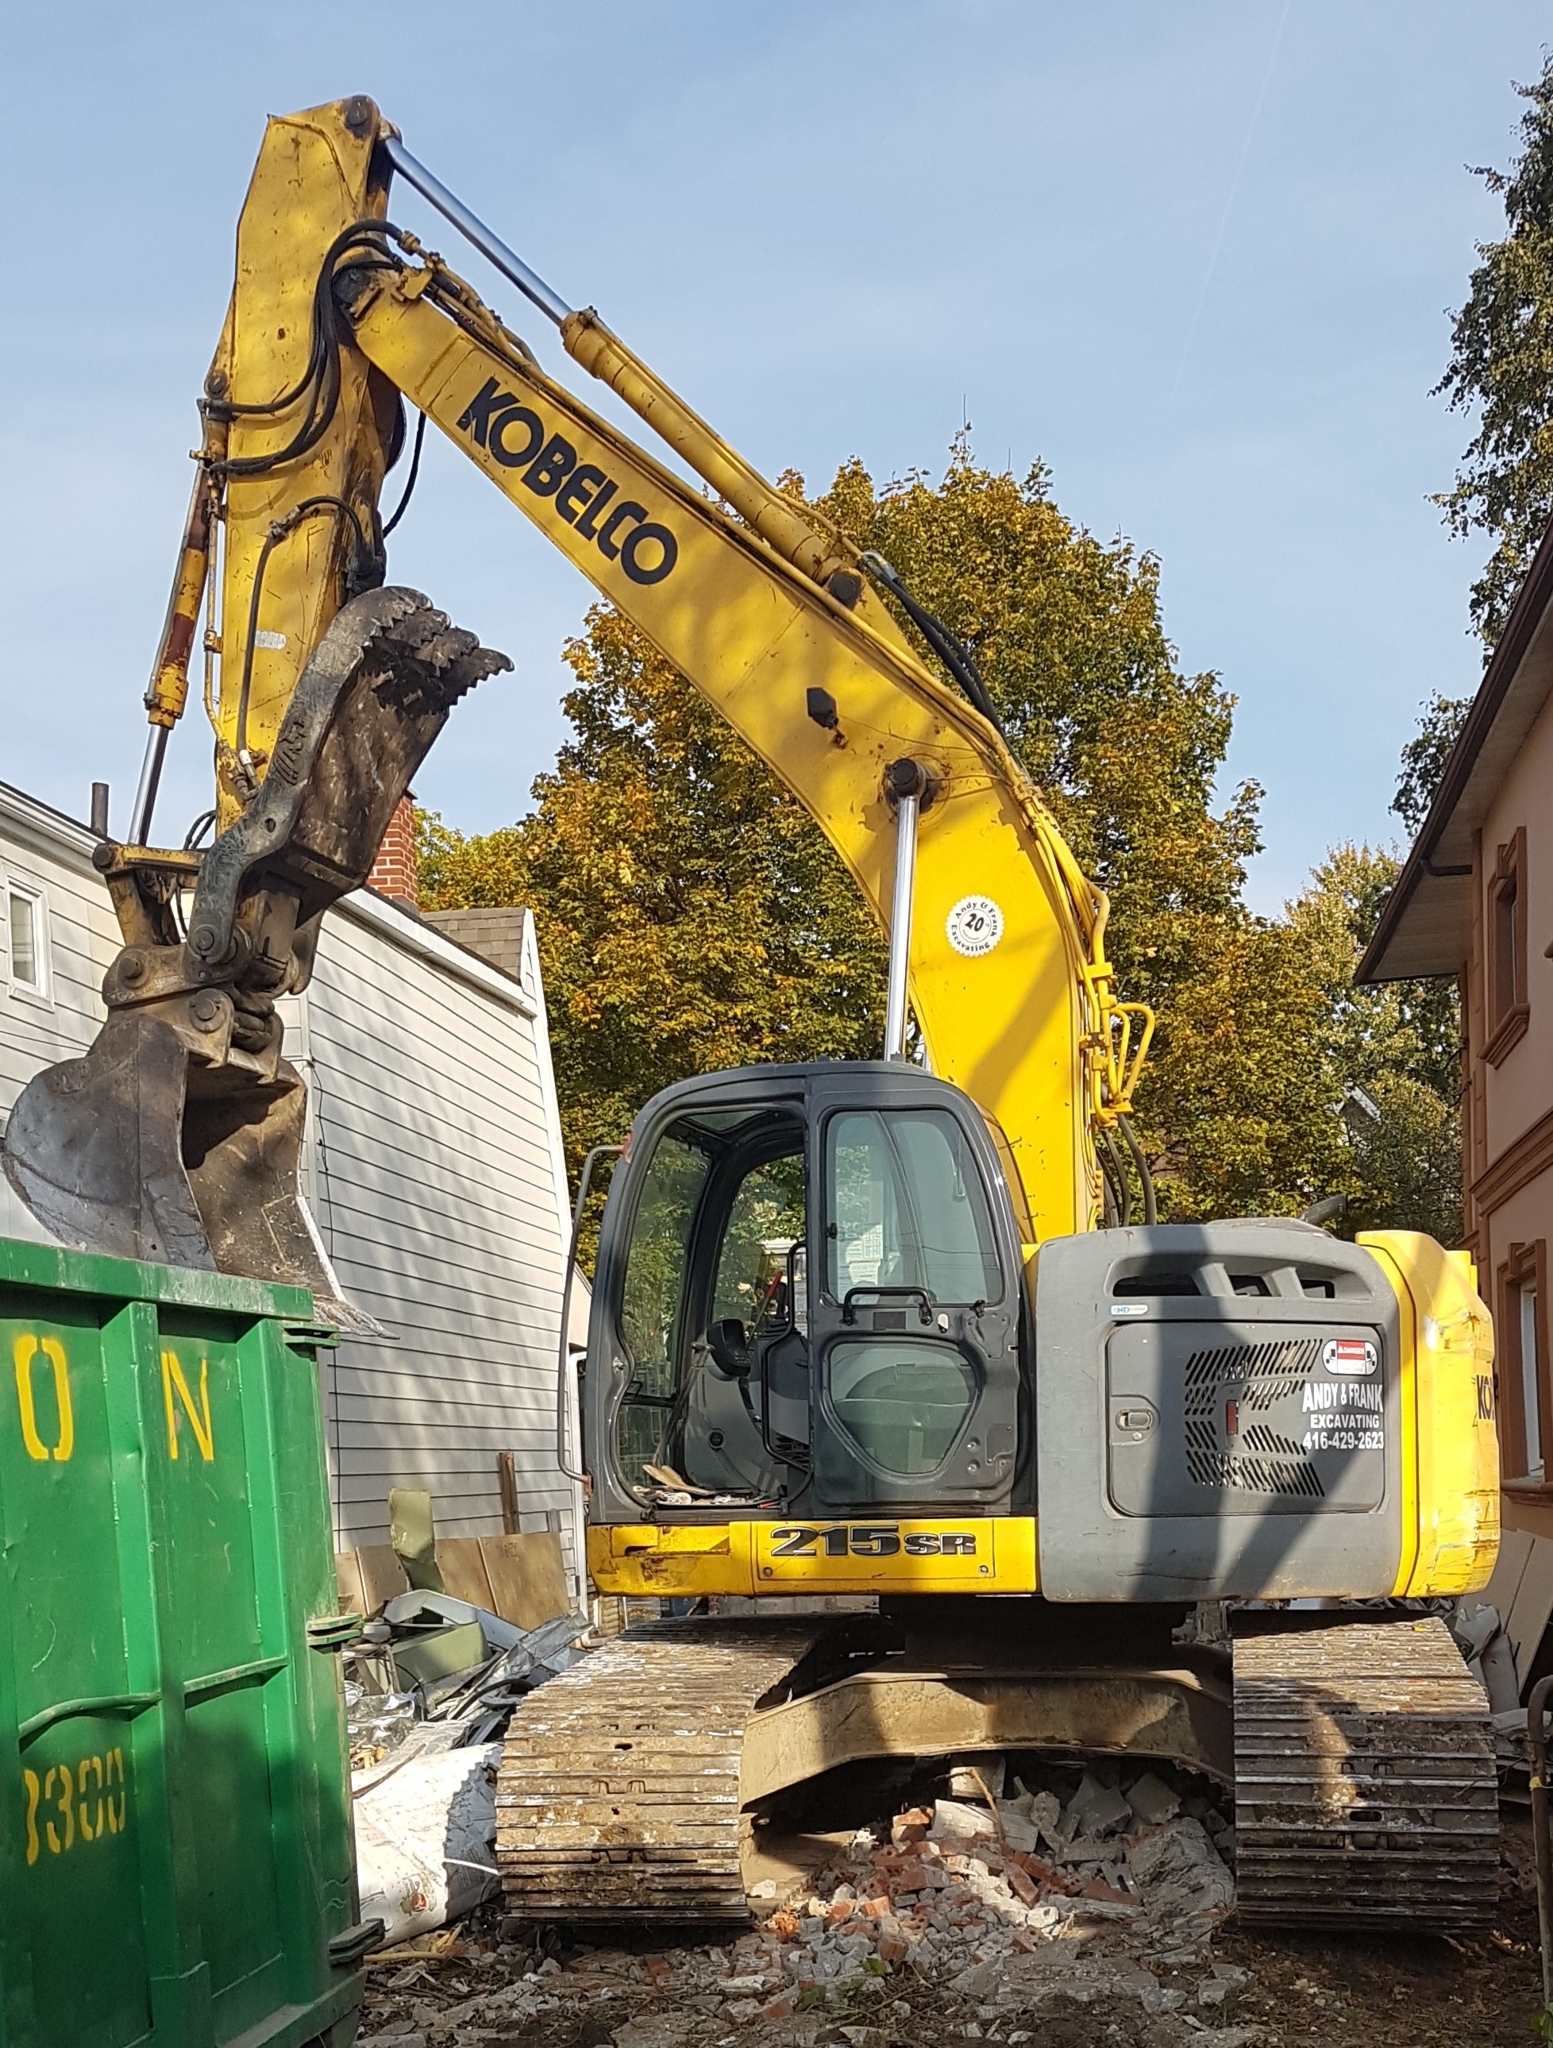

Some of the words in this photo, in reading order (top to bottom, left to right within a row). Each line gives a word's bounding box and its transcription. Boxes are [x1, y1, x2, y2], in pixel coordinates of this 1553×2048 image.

[455, 376, 679, 586] KOBELCO
[955, 902, 977, 919] Andy
[988, 907, 998, 937] Frank
[964, 912, 985, 932] 20
[951, 924, 990, 952] Excavating
[1302, 1383, 1339, 1413] ANDY
[1340, 1383, 1347, 1406] &
[1349, 1383, 1384, 1413] FRANK
[1310, 1414, 1380, 1429] EXCAVATING
[1302, 1431, 1384, 1450] 416-429-2623
